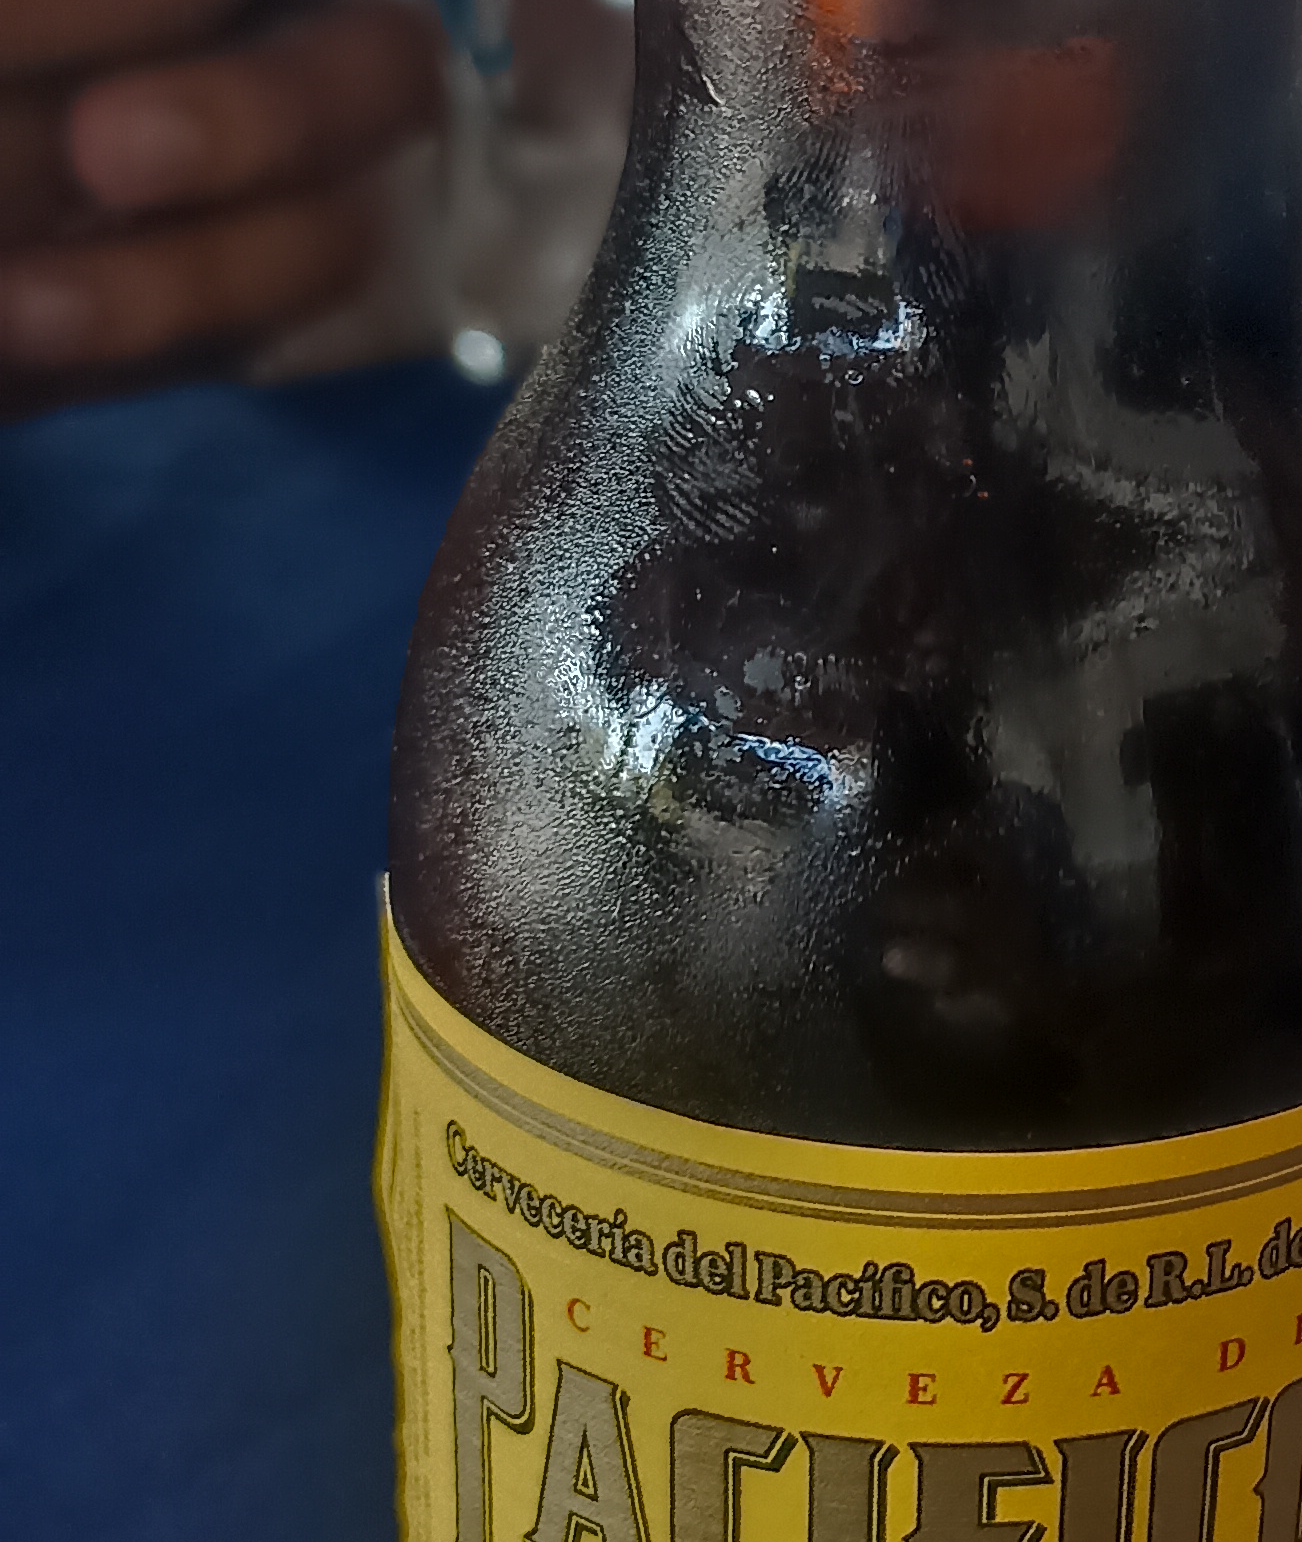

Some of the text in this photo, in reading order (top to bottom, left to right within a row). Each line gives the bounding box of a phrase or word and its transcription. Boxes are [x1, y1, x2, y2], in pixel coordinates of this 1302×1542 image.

[446, 1120, 658, 1276] Cervecería
[663, 1230, 748, 1301] del
[756, 1250, 999, 1333] Pacífico,
[1006, 1267, 1060, 1323] S.
[1066, 1258, 1140, 1320] de
[1144, 1238, 1254, 1309] R.L.
[567, 1299, 1122, 1405] CERVEZA
